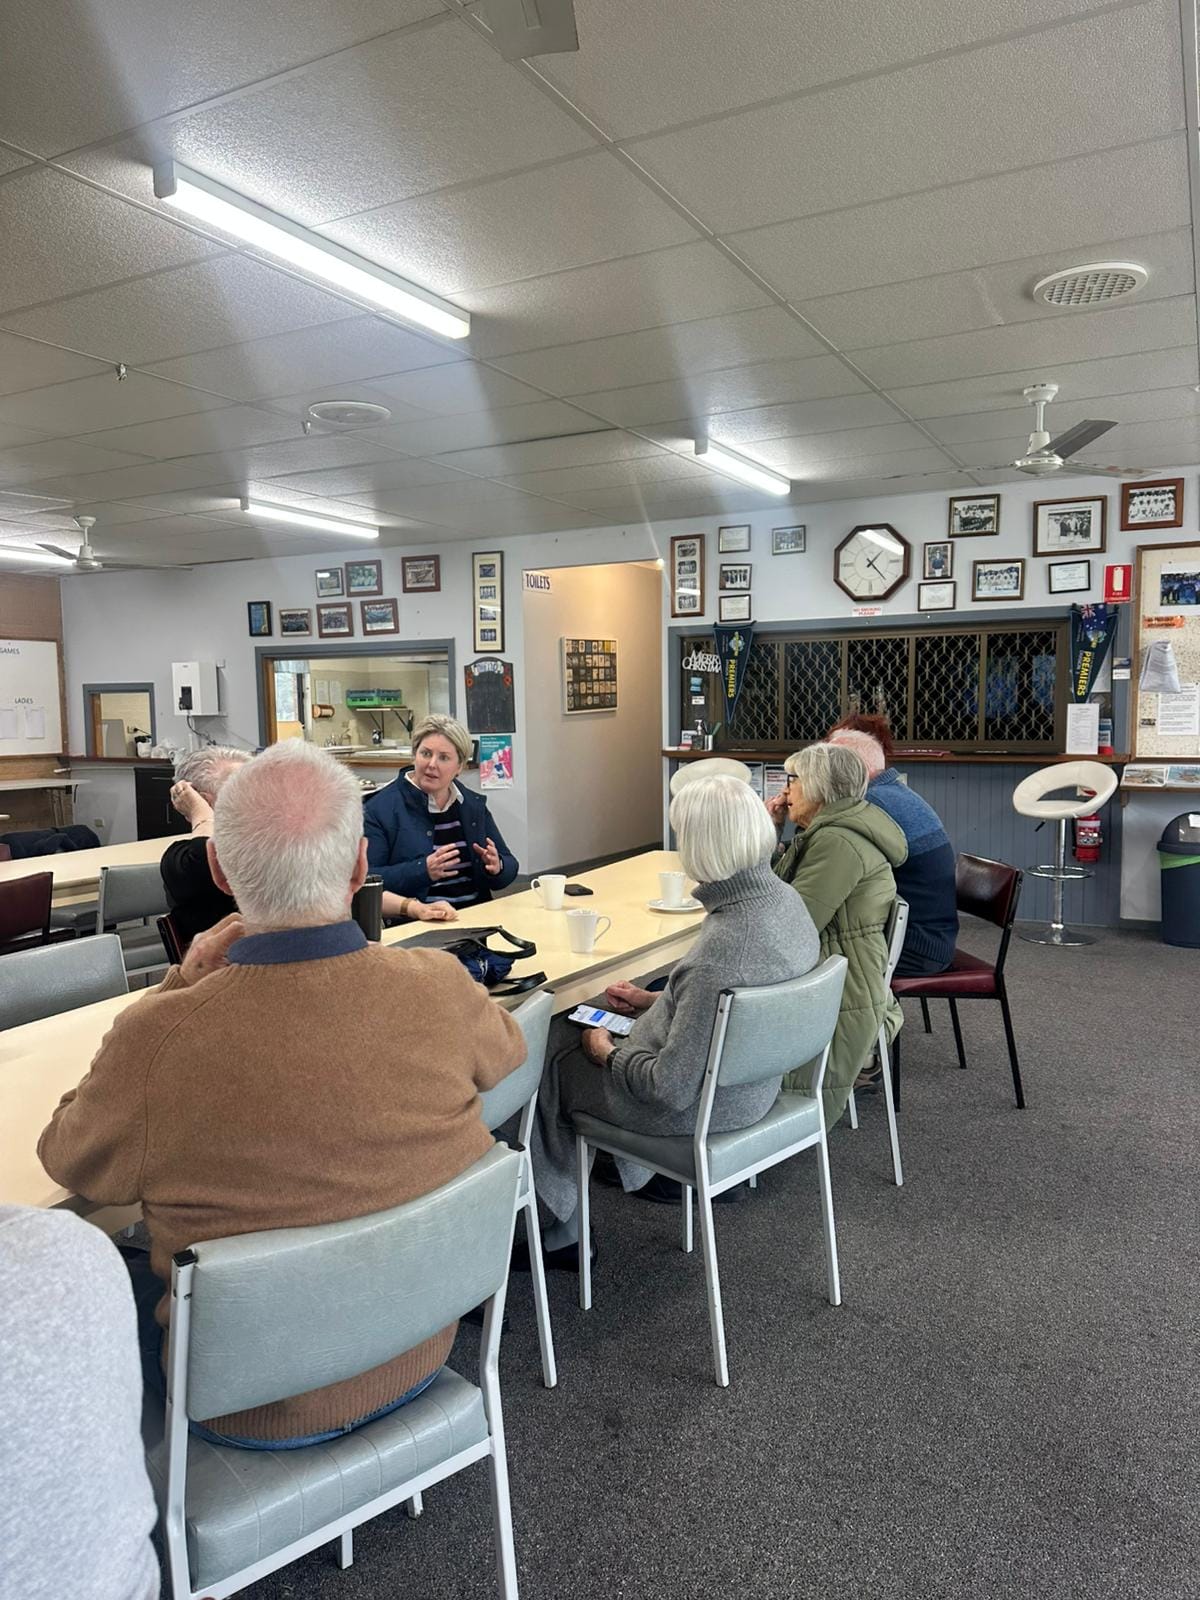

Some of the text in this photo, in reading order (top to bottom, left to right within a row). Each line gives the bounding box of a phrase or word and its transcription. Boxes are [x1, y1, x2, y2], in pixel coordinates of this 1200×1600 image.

[525, 573, 550, 590] TOILETS
[727, 659, 736, 698] PREMIERS
[1077, 650, 1092, 696] PREMIERS
